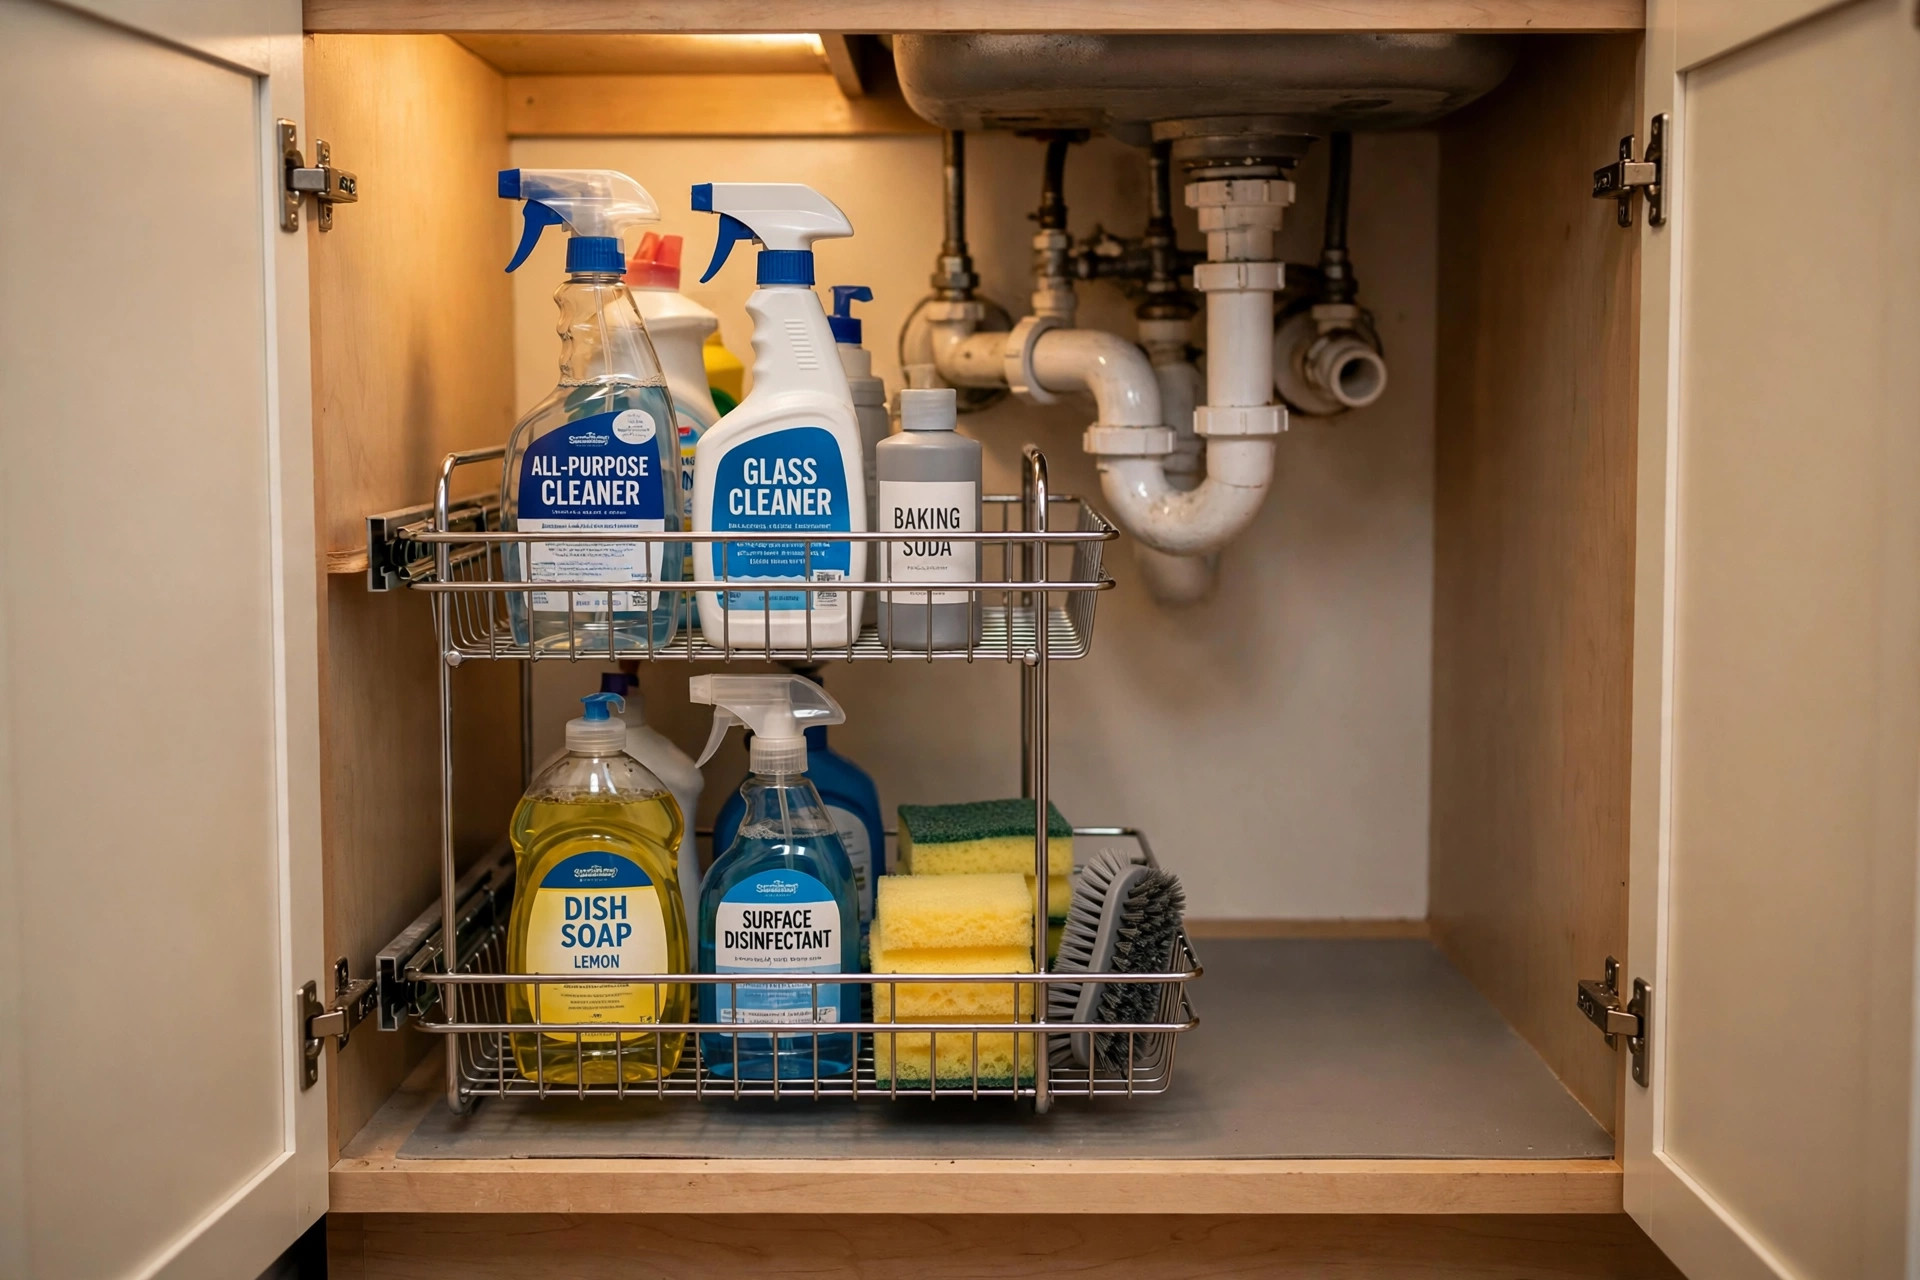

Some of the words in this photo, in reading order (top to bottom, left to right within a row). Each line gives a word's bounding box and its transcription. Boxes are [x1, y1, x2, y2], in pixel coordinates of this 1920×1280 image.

[531, 455, 649, 477] ALL-PURPOSE
[743, 457, 818, 485] GLASS
[541, 479, 640, 506] CLEANER
[728, 487, 832, 516] CLEANER
[894, 507, 961, 530] BAKING
[903, 541, 952, 557] SODA
[564, 895, 628, 921] DISH
[742, 909, 812, 929] SURFACE
[560, 922, 632, 948] SOAP
[724, 929, 832, 950] DISINFECTANT
[573, 954, 620, 969] LEMON
